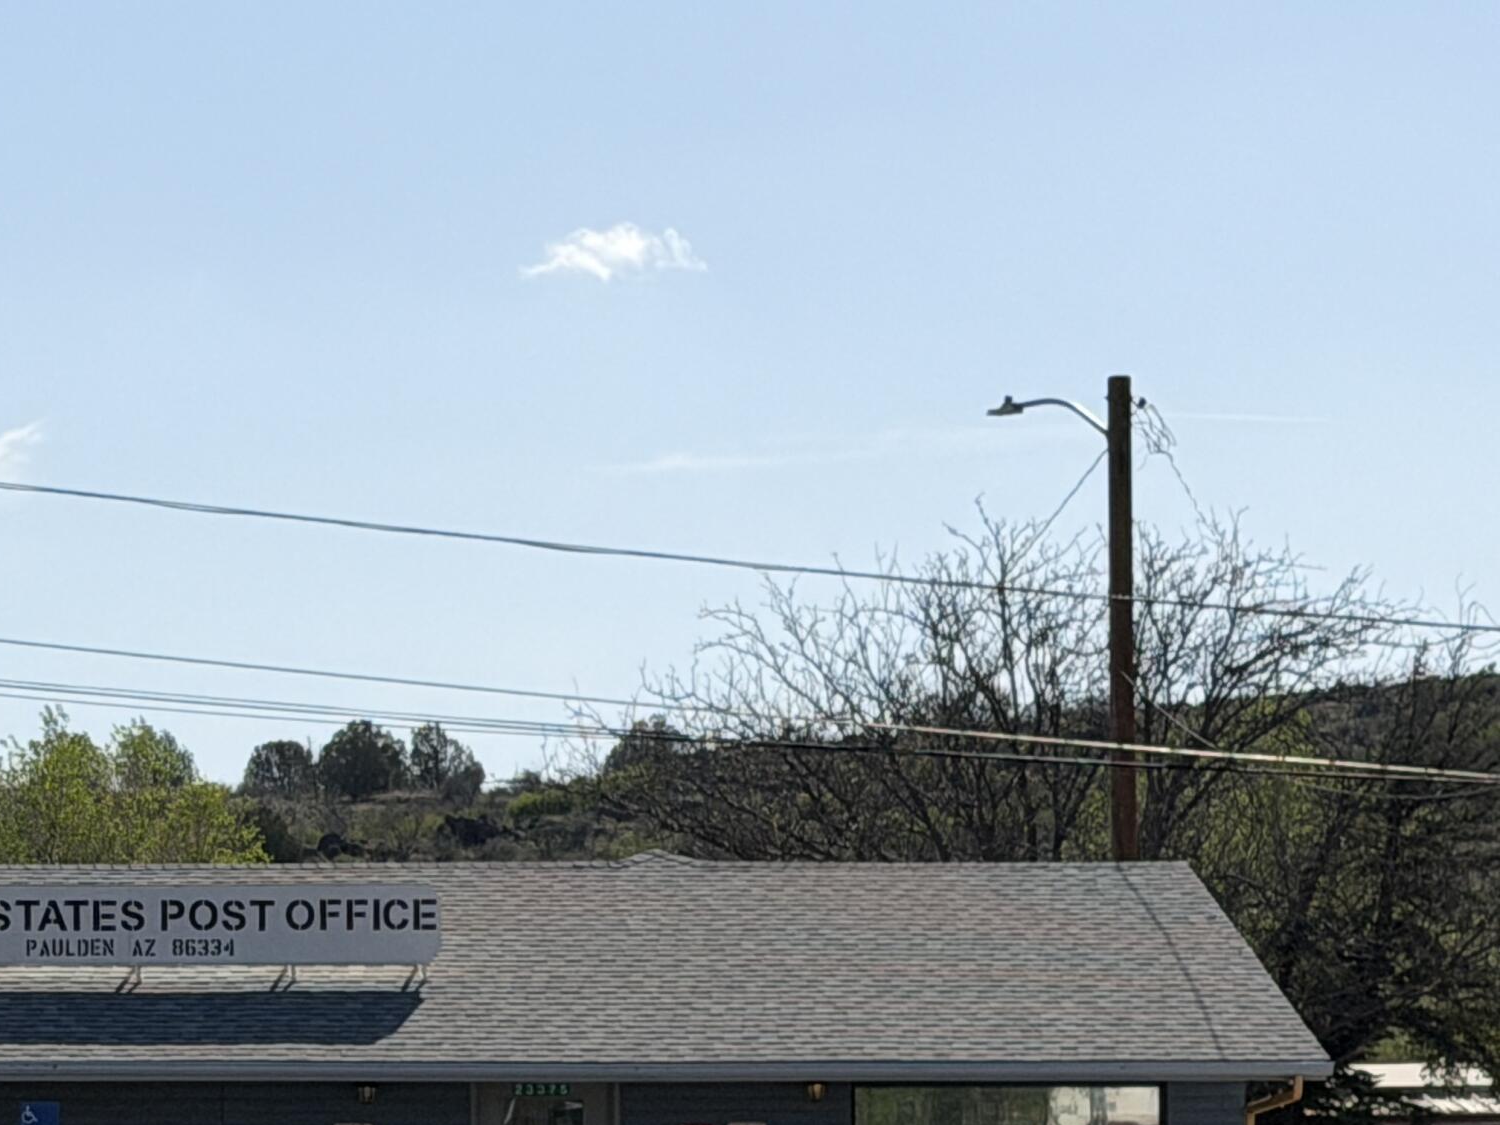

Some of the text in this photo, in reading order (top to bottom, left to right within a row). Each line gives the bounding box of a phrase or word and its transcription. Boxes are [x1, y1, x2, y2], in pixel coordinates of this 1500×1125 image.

[160, 899, 275, 932] POST
[285, 899, 437, 931] OFFICE
[26, 938, 235, 957] PAULDEN AZ 86334
